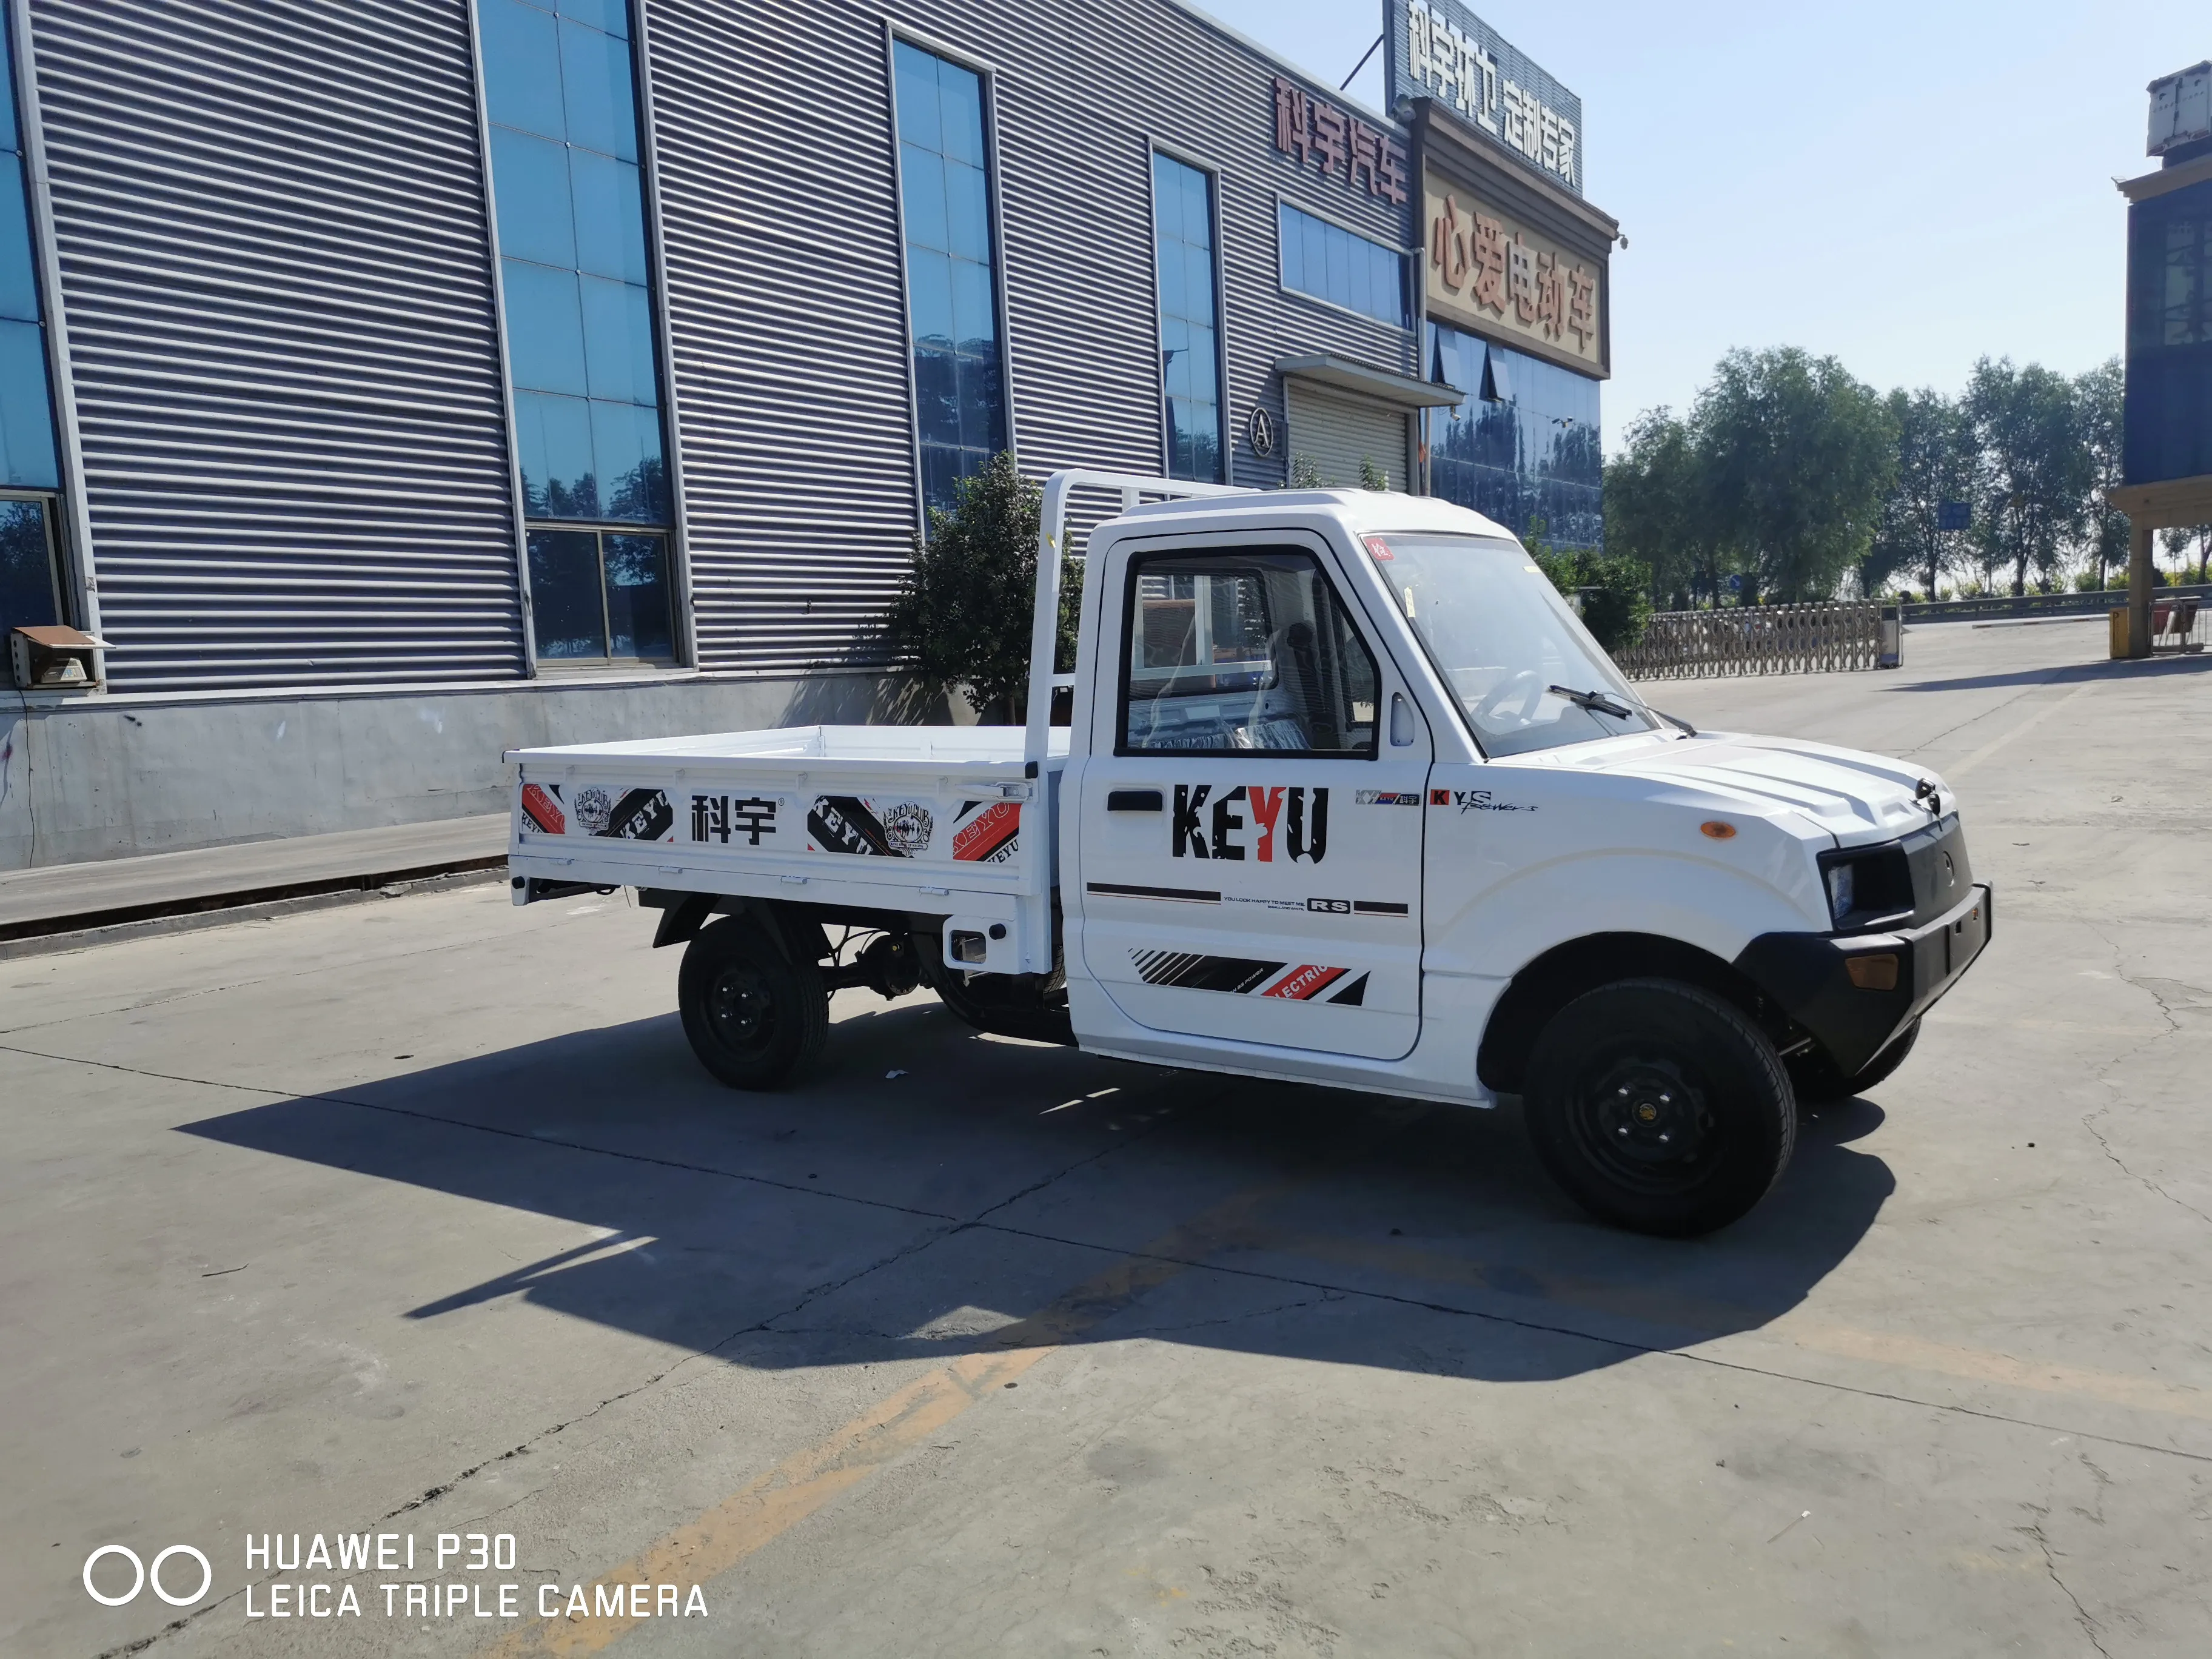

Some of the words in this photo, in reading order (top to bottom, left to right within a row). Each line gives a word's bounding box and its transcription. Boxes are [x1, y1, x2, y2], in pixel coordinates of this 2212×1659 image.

[1276, 78, 1407, 204] 科宇汽车
[1503, 79, 1576, 186] 定制专家
[1434, 194, 1595, 350] 心爱电动车
[692, 795, 776, 845] 科宇
[1173, 785, 1329, 864] KEYU
